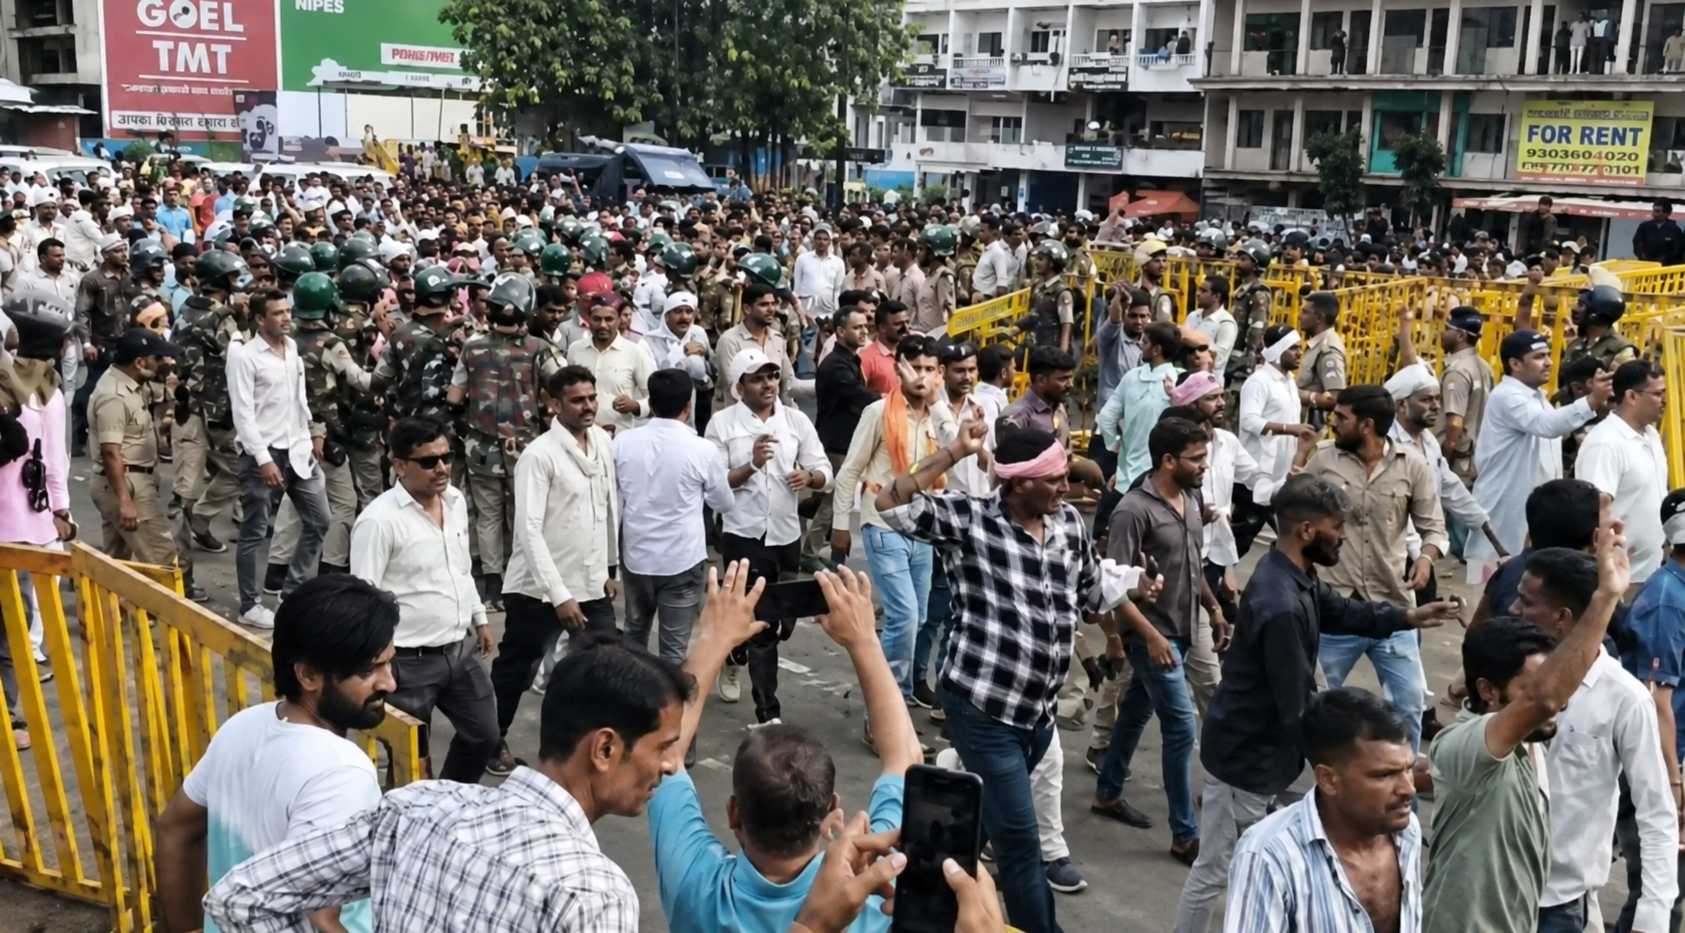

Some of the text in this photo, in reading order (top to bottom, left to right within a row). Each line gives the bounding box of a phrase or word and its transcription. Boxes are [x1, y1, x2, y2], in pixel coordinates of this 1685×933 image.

[137, 0, 245, 33] GOEL
[295, 0, 345, 14] NIPES
[152, 40, 233, 74] TMT
[1527, 124, 1643, 147] FOR RENT
[1526, 148, 1639, 162] 9303604020
